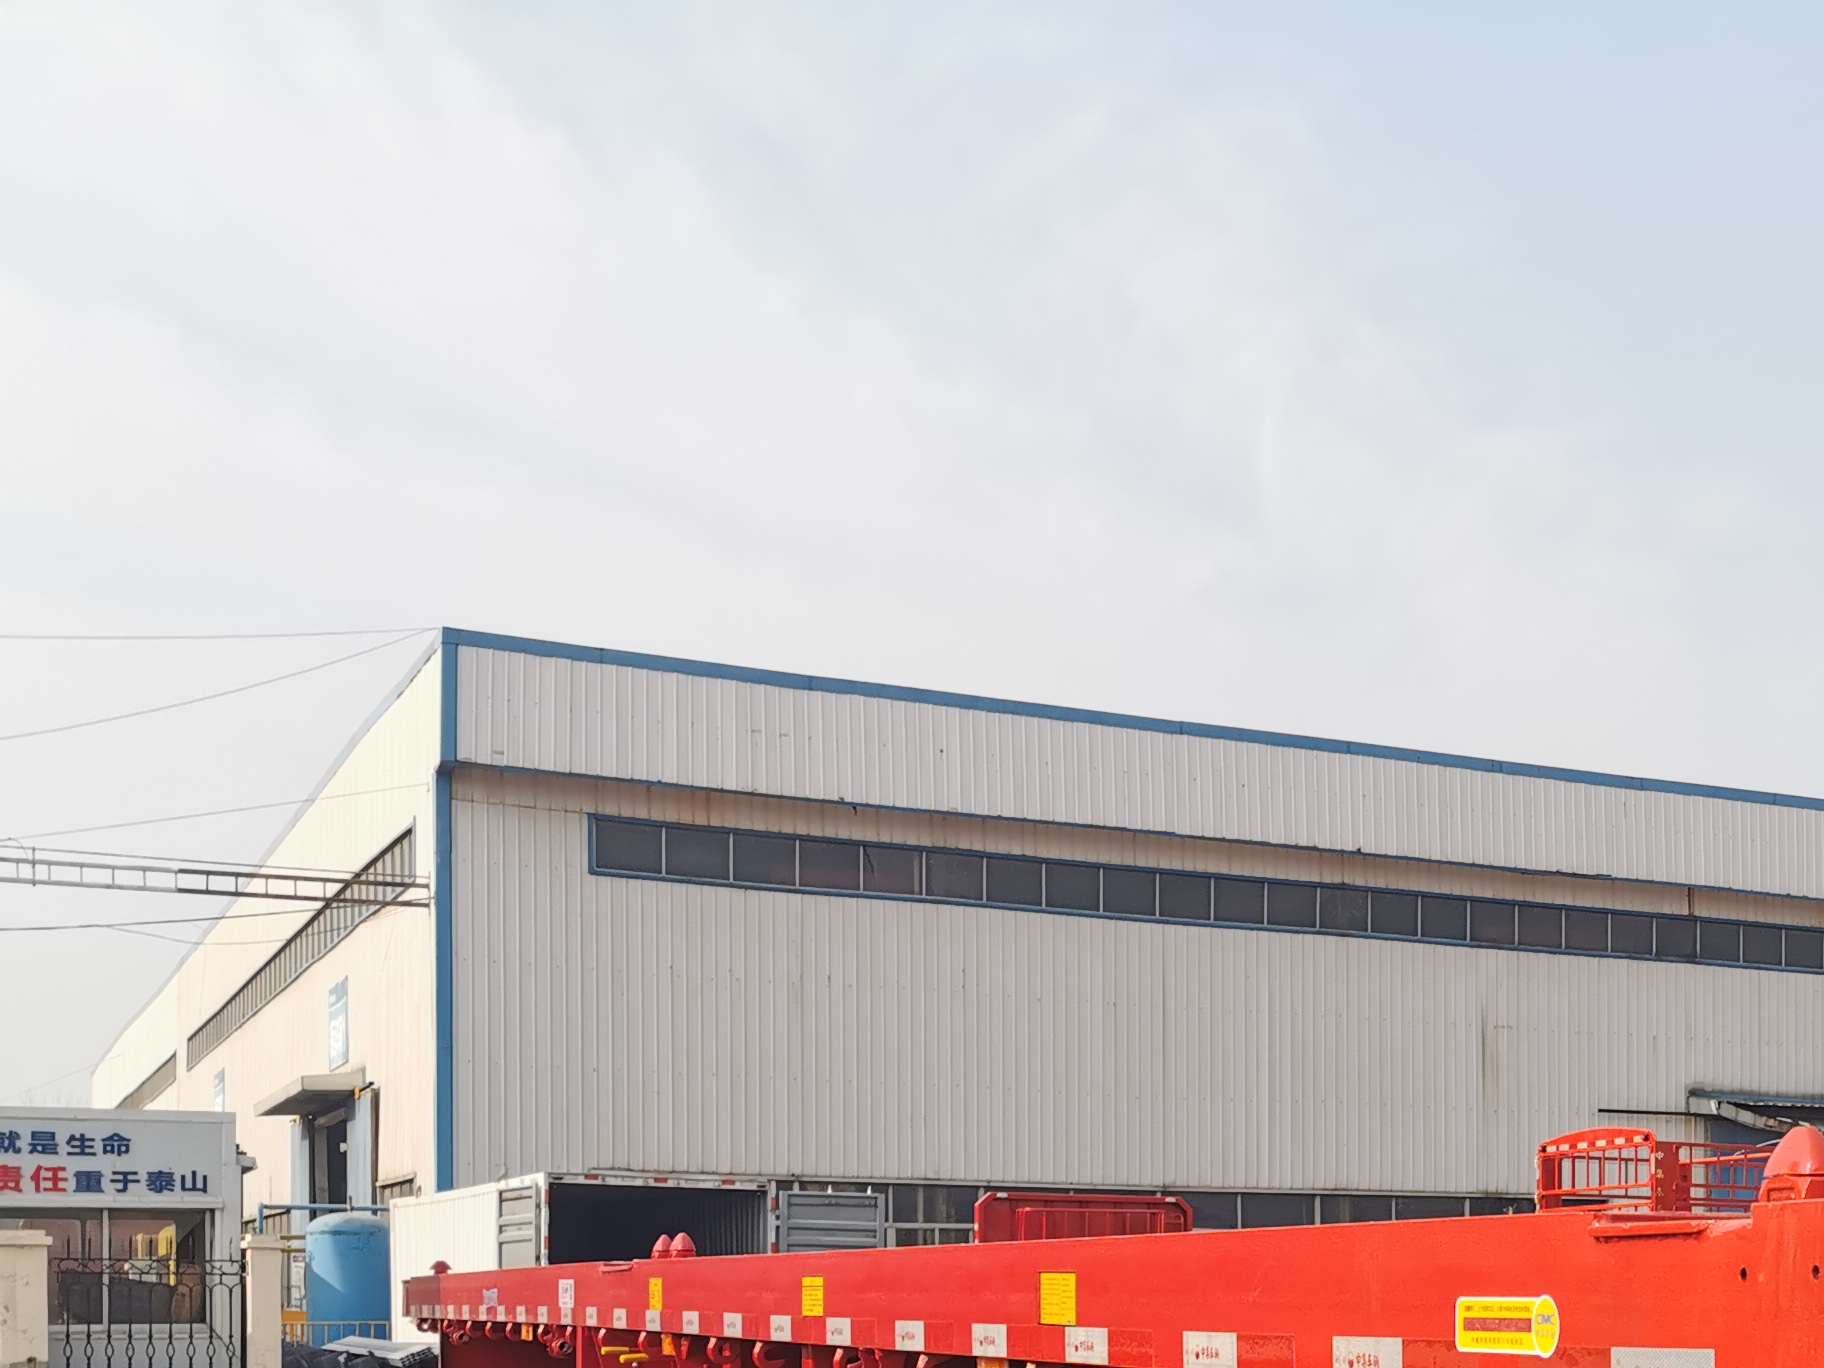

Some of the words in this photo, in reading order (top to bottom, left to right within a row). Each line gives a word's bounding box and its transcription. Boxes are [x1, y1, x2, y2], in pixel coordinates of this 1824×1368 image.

[0, 1130, 131, 1156] 就是生命
[0, 1164, 208, 1194] 责任重于泰山
